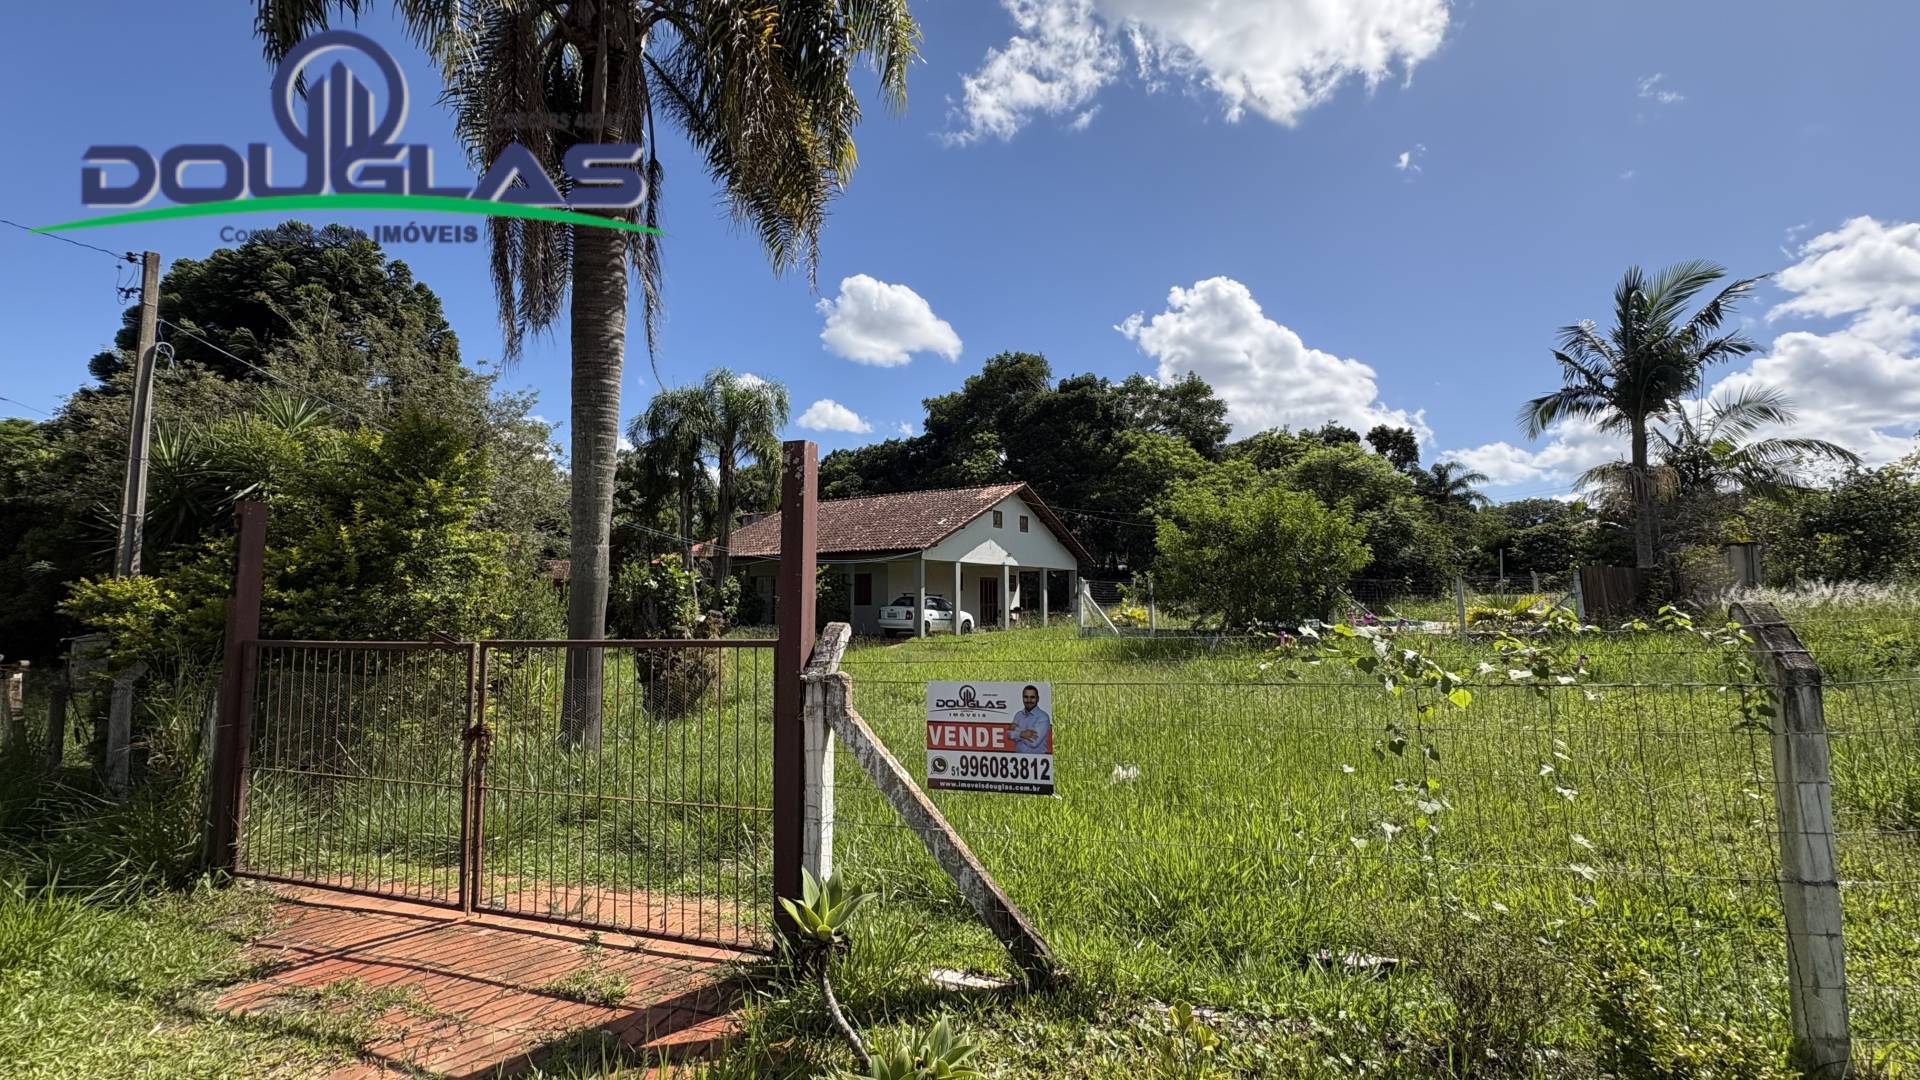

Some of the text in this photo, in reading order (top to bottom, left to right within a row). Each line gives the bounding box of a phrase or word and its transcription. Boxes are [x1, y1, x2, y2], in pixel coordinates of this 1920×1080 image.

[935, 699, 1007, 710] DOUGLAS
[928, 724, 1005, 748] VENDE
[960, 755, 1051, 781] 996083812
[939, 781, 1041, 792] www.imoveisdouglas.com.br
